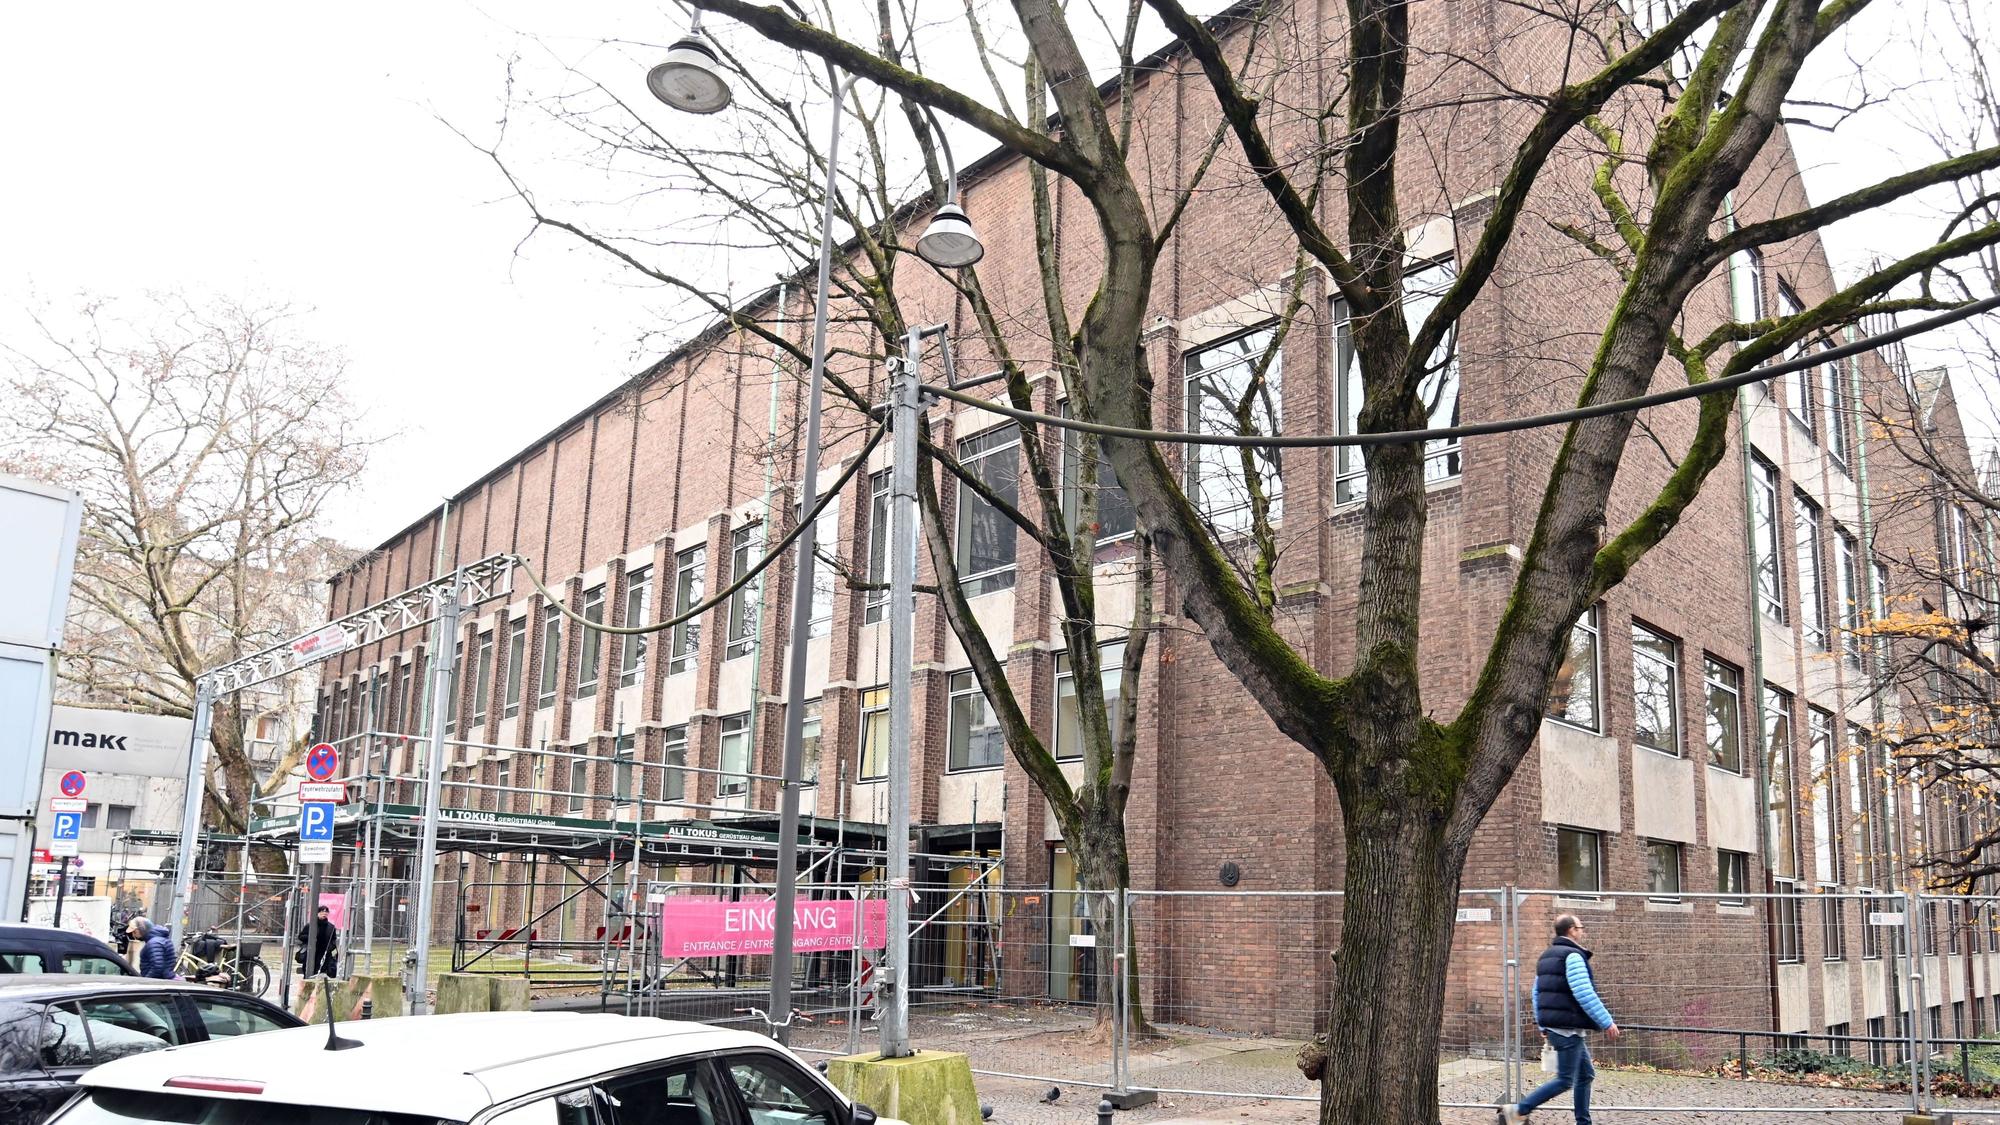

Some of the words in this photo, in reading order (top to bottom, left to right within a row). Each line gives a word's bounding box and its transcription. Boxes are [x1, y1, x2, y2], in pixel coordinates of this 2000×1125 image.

[56, 815, 74, 837] P
[305, 806, 325, 836] P
[438, 809, 453, 821] ALI
[456, 811, 496, 822] TOKUS
[498, 816, 536, 825] GERÜSTBAU
[537, 819, 556, 827] GmbH
[668, 827, 684, 836] ALI
[686, 828, 718, 838] TOKUS
[718, 832, 750, 841] GERÜSTBAU
[683, 940, 737, 952] ENTRANCE
